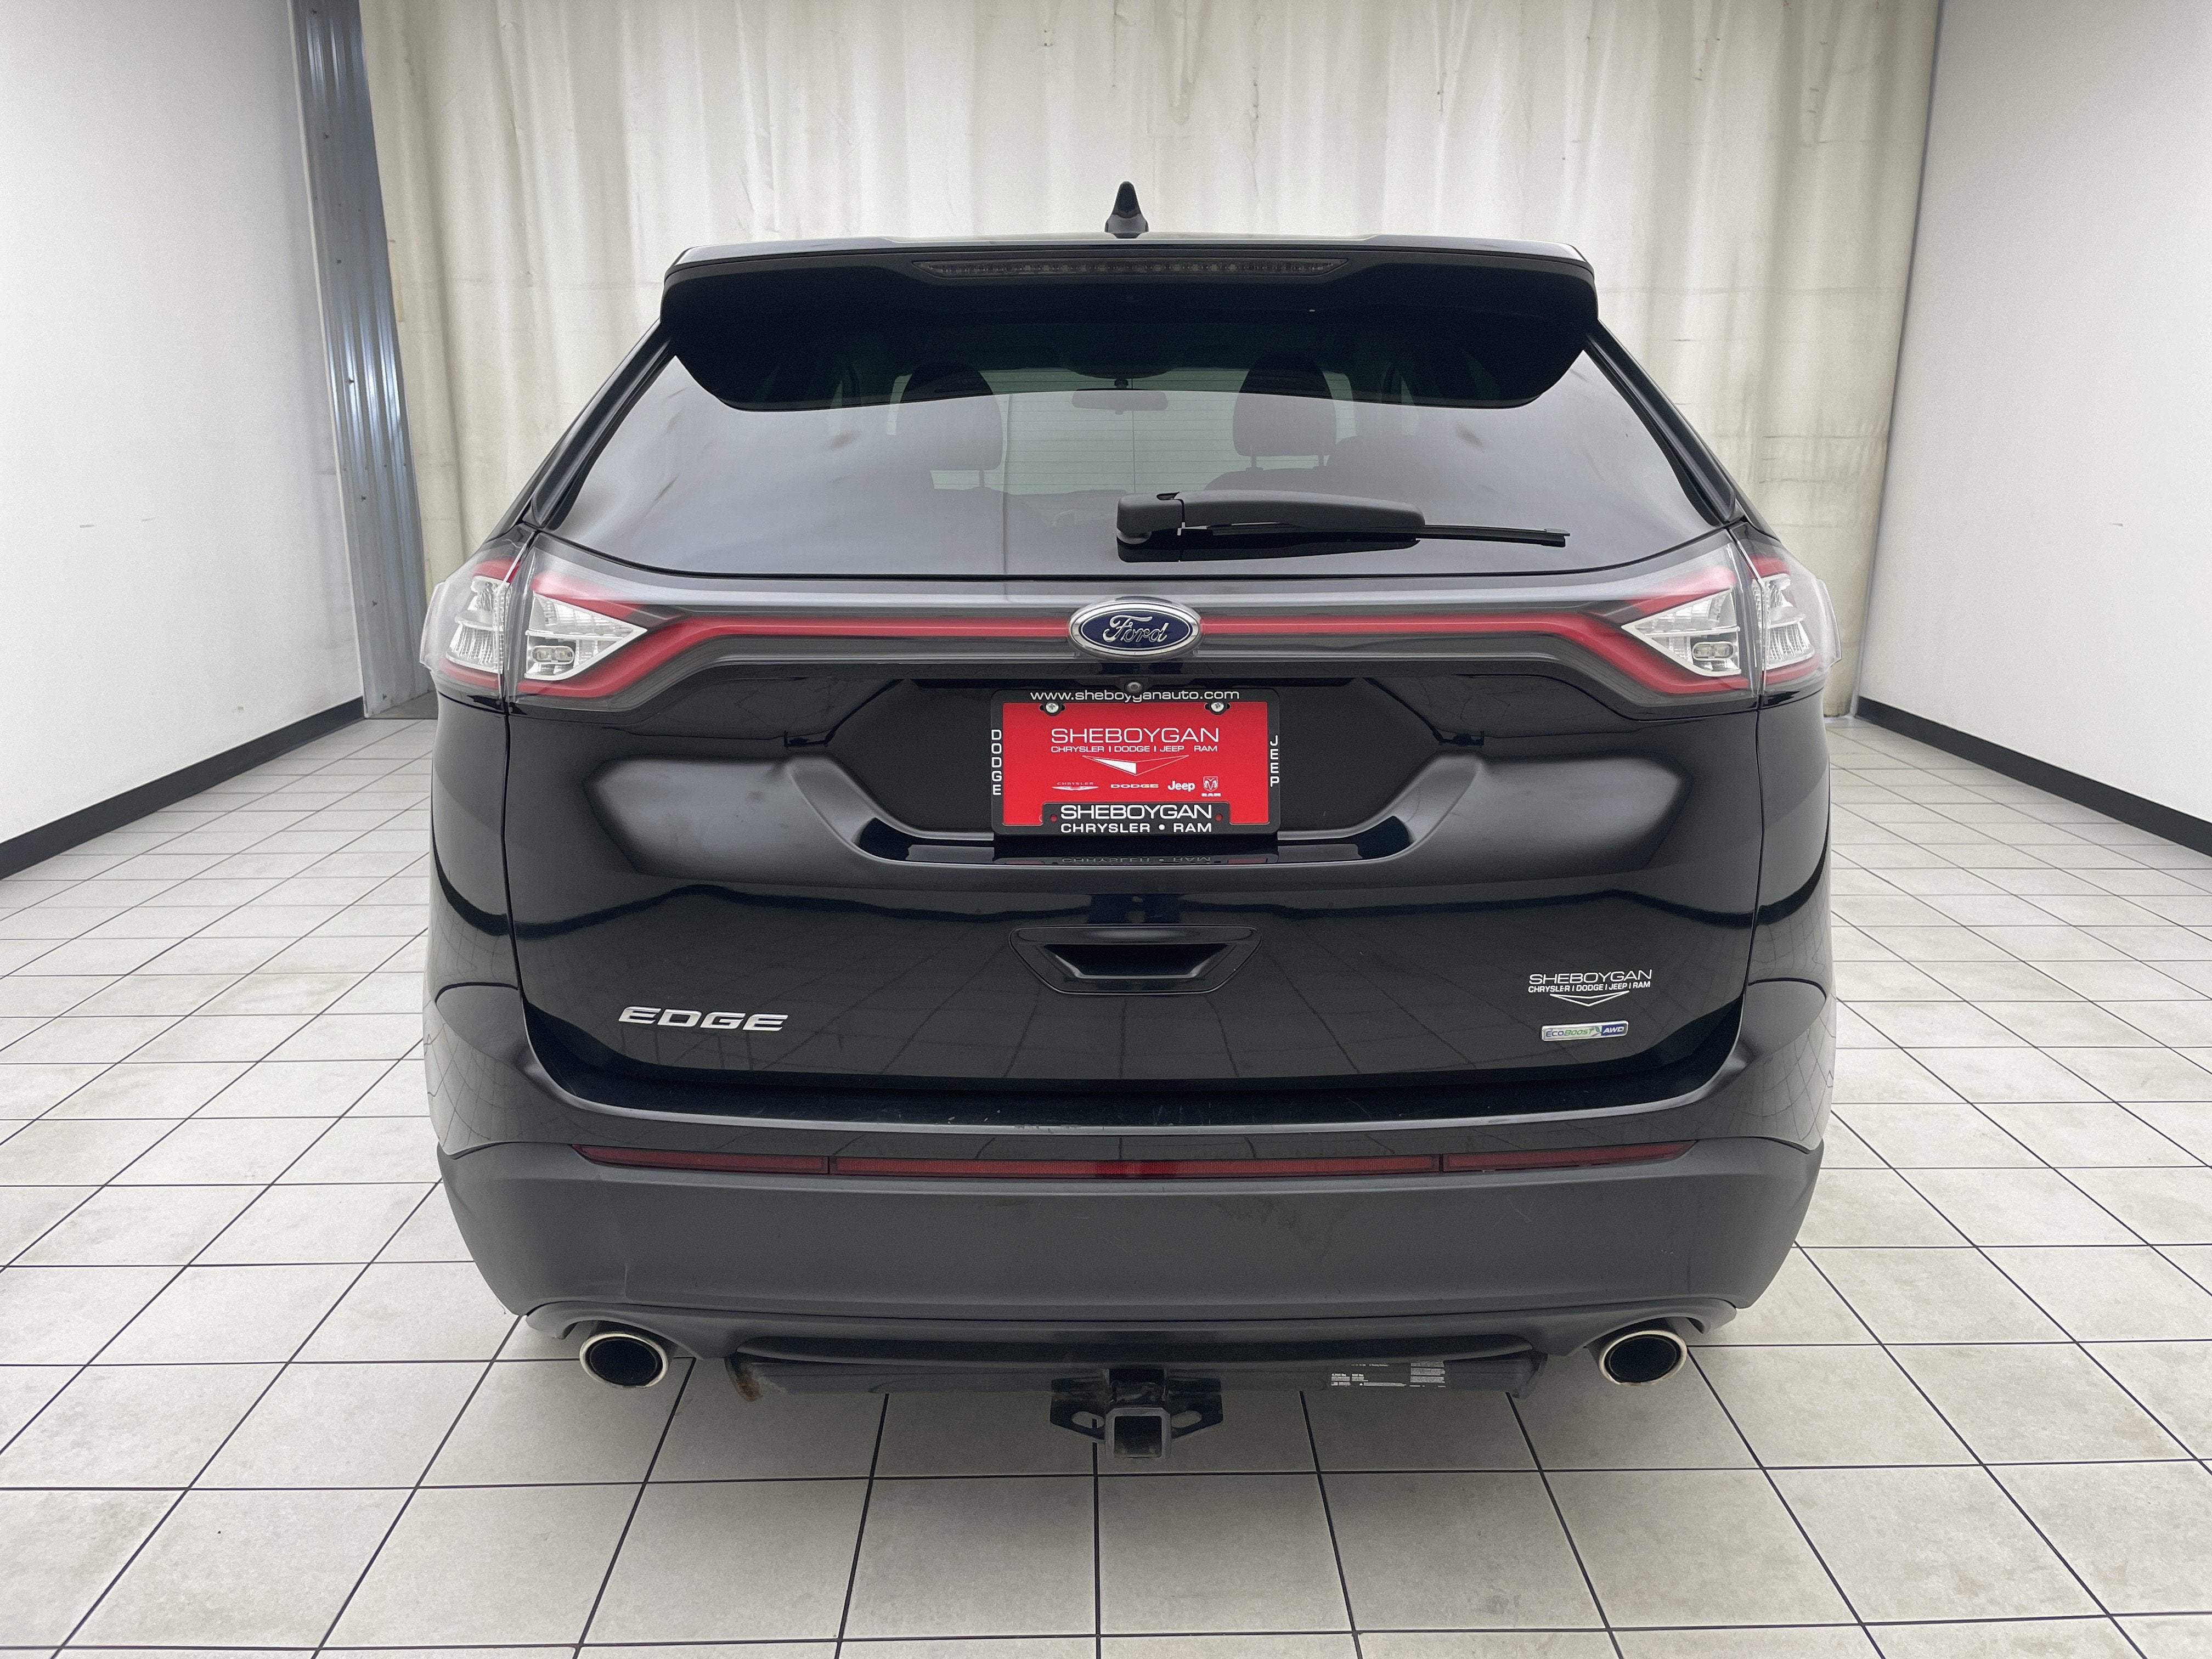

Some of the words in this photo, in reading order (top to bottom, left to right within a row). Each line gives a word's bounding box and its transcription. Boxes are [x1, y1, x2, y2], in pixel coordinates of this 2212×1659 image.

[1102, 614, 1169, 643] Ford
[1051, 727, 1219, 743] SHEBOYGAN
[991, 729, 1002, 795] DODGE
[1269, 735, 1280, 787] JEEP
[1167, 780, 1195, 792] Jeep
[1060, 804, 1212, 820] SHEBOYGAN
[1060, 823, 1150, 833] CHRYSLER
[1173, 822, 1212, 833] RAM
[1528, 969, 1652, 985] SHEBOYGAN
[1528, 985, 1570, 993] CHRYSLER
[1576, 984, 1604, 992] DODGE
[618, 1006, 789, 1031] EDGE
[1602, 1026, 1625, 1034] AWD
